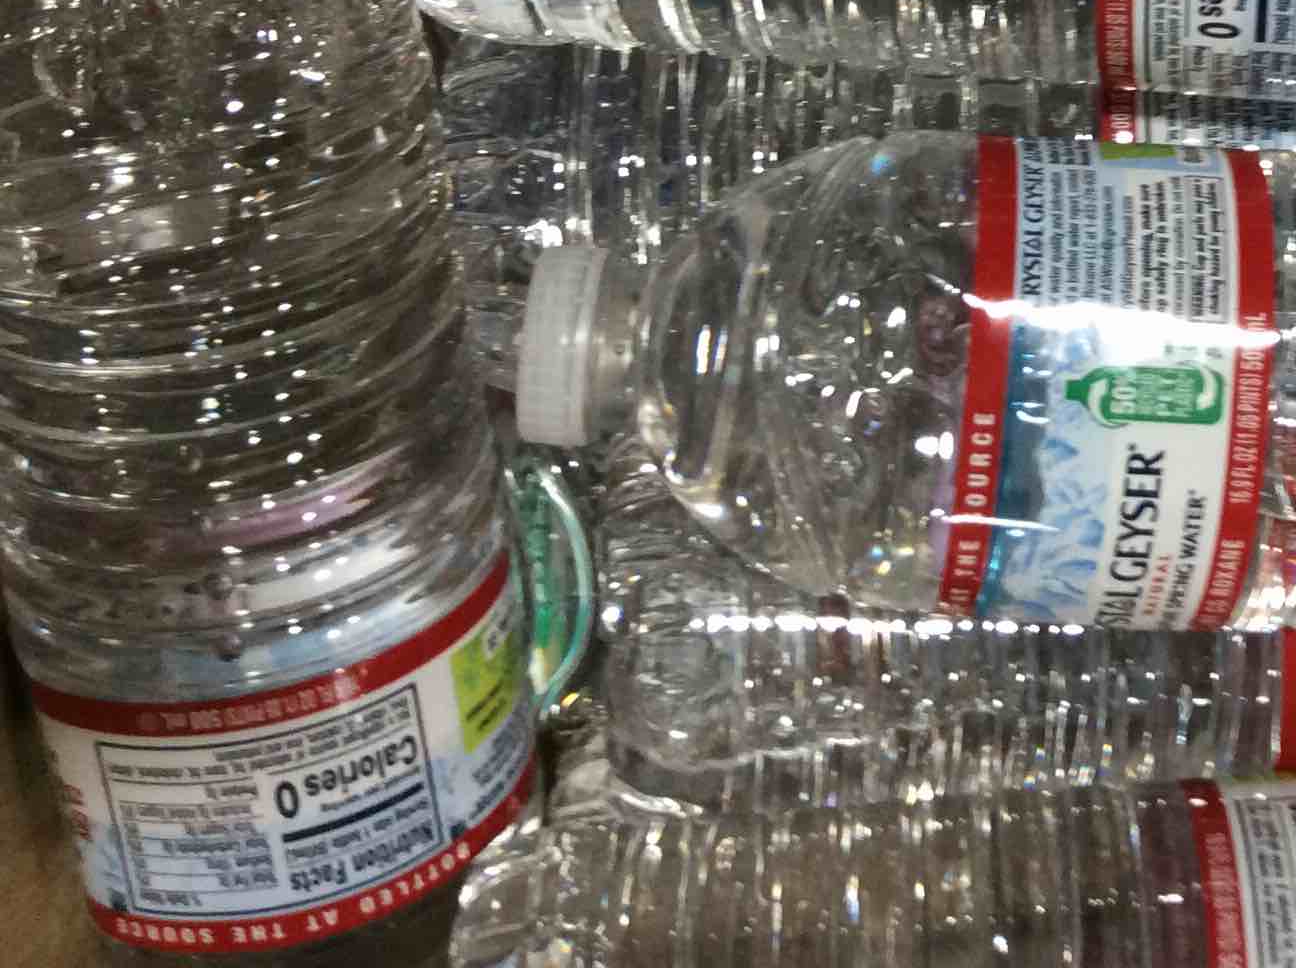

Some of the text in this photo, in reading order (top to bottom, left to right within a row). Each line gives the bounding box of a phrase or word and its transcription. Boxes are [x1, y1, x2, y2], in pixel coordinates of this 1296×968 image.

[1196, 21, 1241, 41] 0
[1020, 164, 1043, 296] RYSTAL GEYSER
[959, 410, 998, 519] OURCE
[1107, 445, 1165, 584] GEYSER
[1175, 494, 1207, 560] WATER
[1207, 537, 1245, 597] ROXANE
[302, 734, 416, 798] Calories
[270, 777, 303, 821] 0
[287, 859, 348, 894] Facts
[356, 841, 471, 914] BOTTLED
[228, 920, 286, 943] THE
[302, 905, 341, 933] AT
